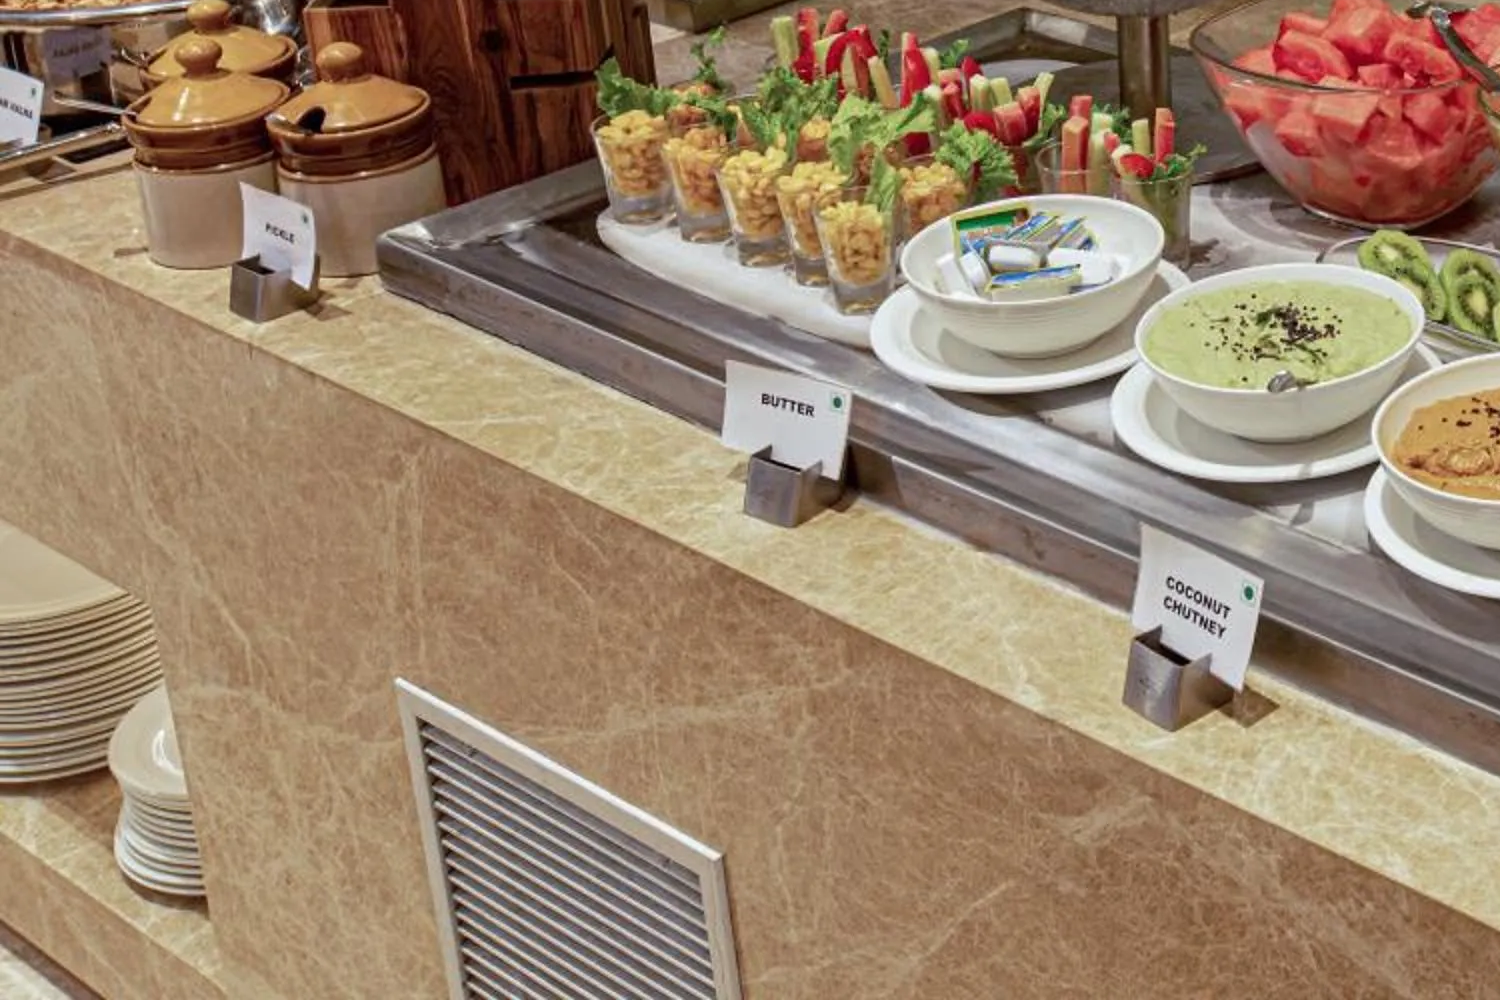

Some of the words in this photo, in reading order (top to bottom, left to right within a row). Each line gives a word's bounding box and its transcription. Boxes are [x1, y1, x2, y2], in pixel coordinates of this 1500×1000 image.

[761, 393, 815, 417] BUTTER
[1163, 596, 1227, 639] CHUTNEY
[1165, 576, 1231, 619] COCONUT
